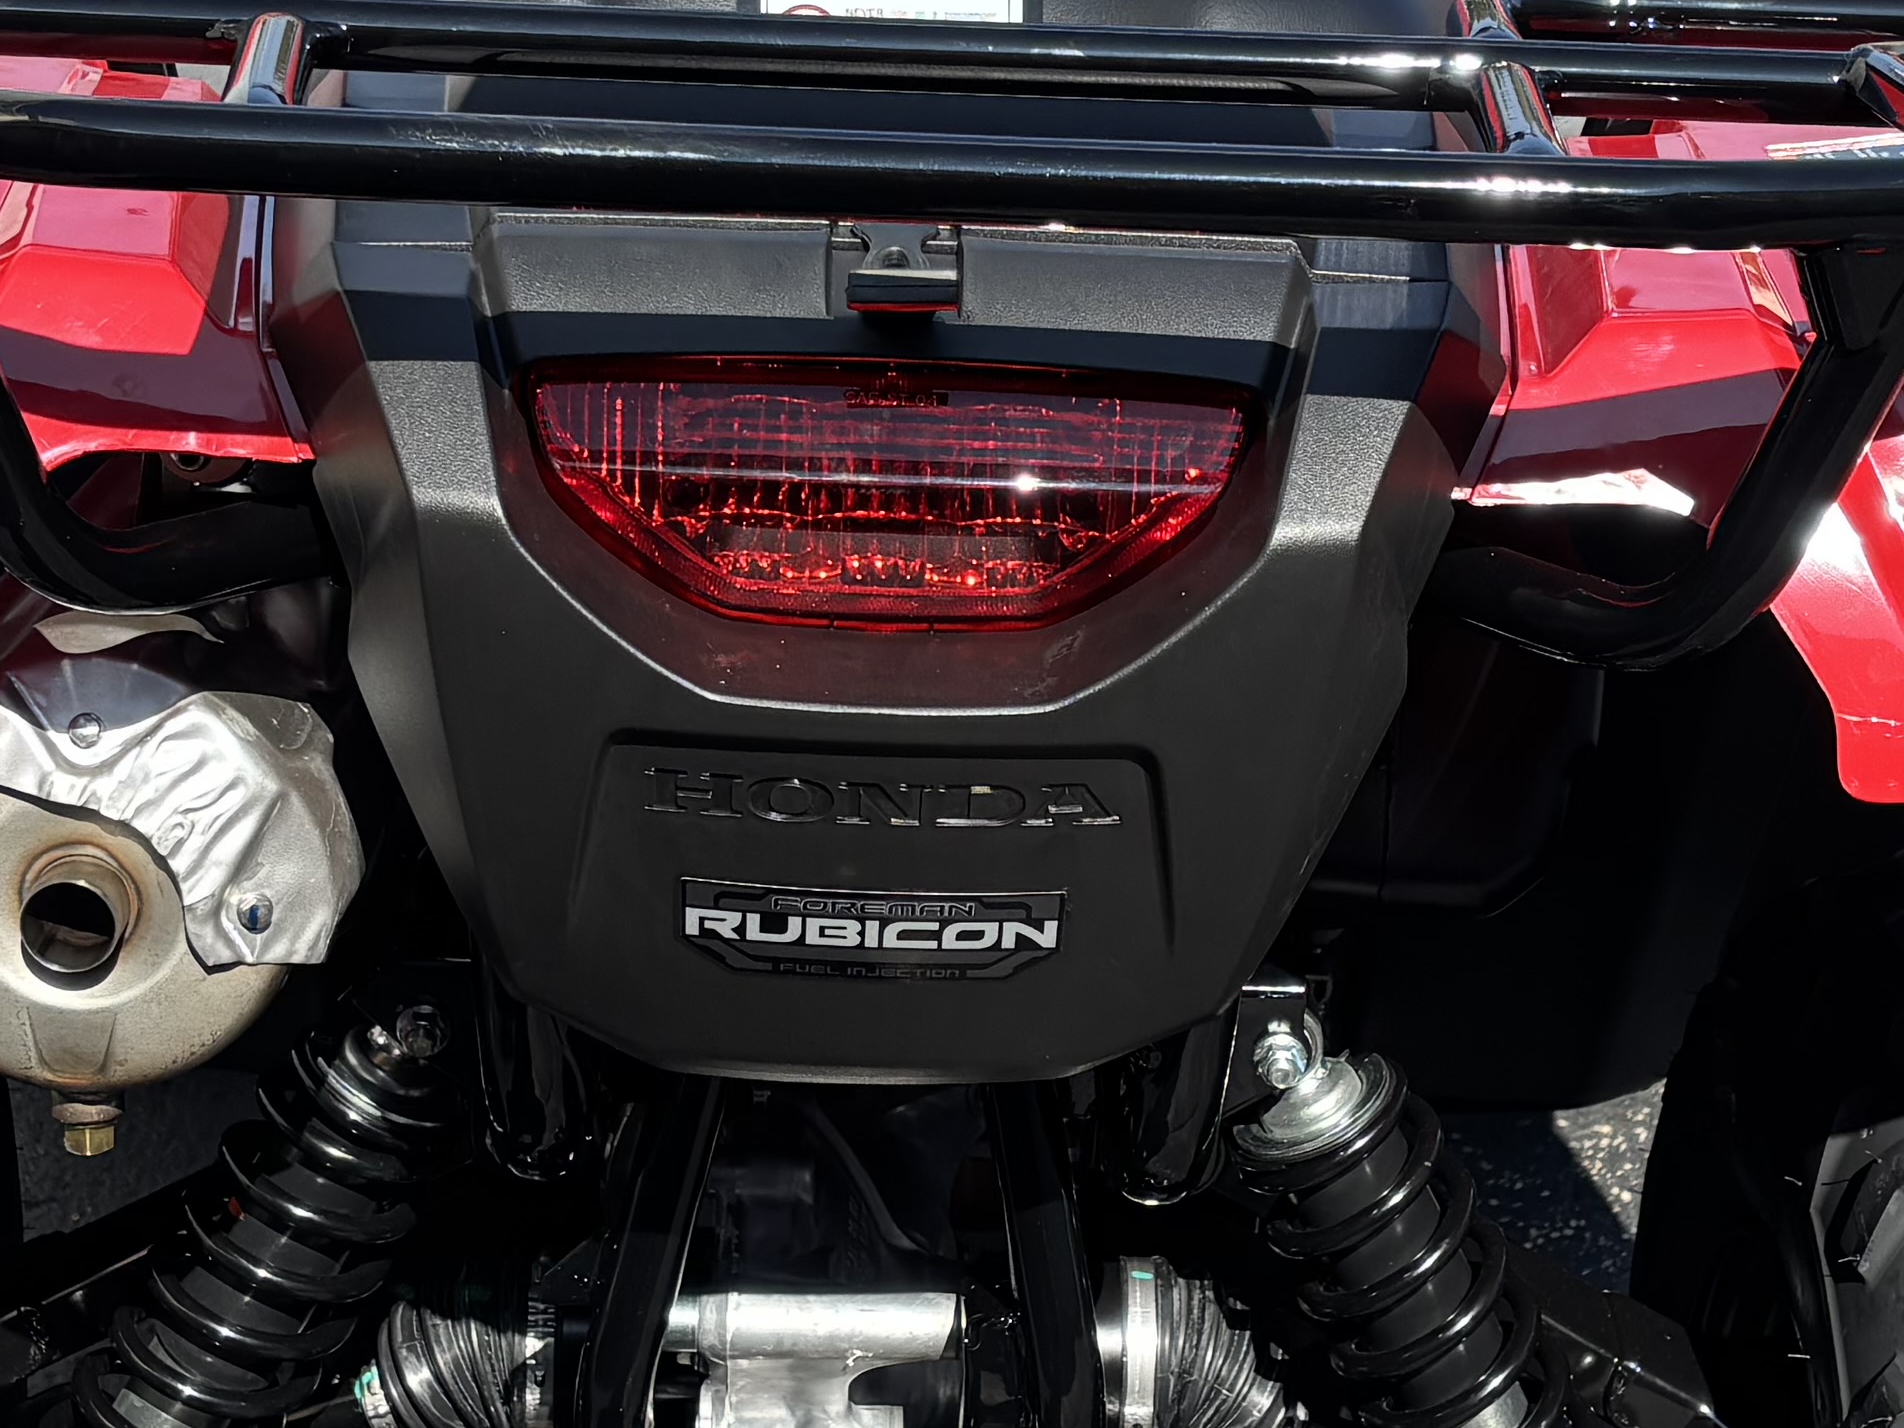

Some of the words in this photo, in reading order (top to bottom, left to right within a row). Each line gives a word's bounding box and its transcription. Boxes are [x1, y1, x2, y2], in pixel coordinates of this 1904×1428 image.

[644, 766, 1122, 828] HONDA
[770, 895, 977, 918] FOREMAN
[684, 906, 1060, 951] RUBICON
[780, 962, 842, 977] FUEL
[847, 963, 961, 980] INJECTION
